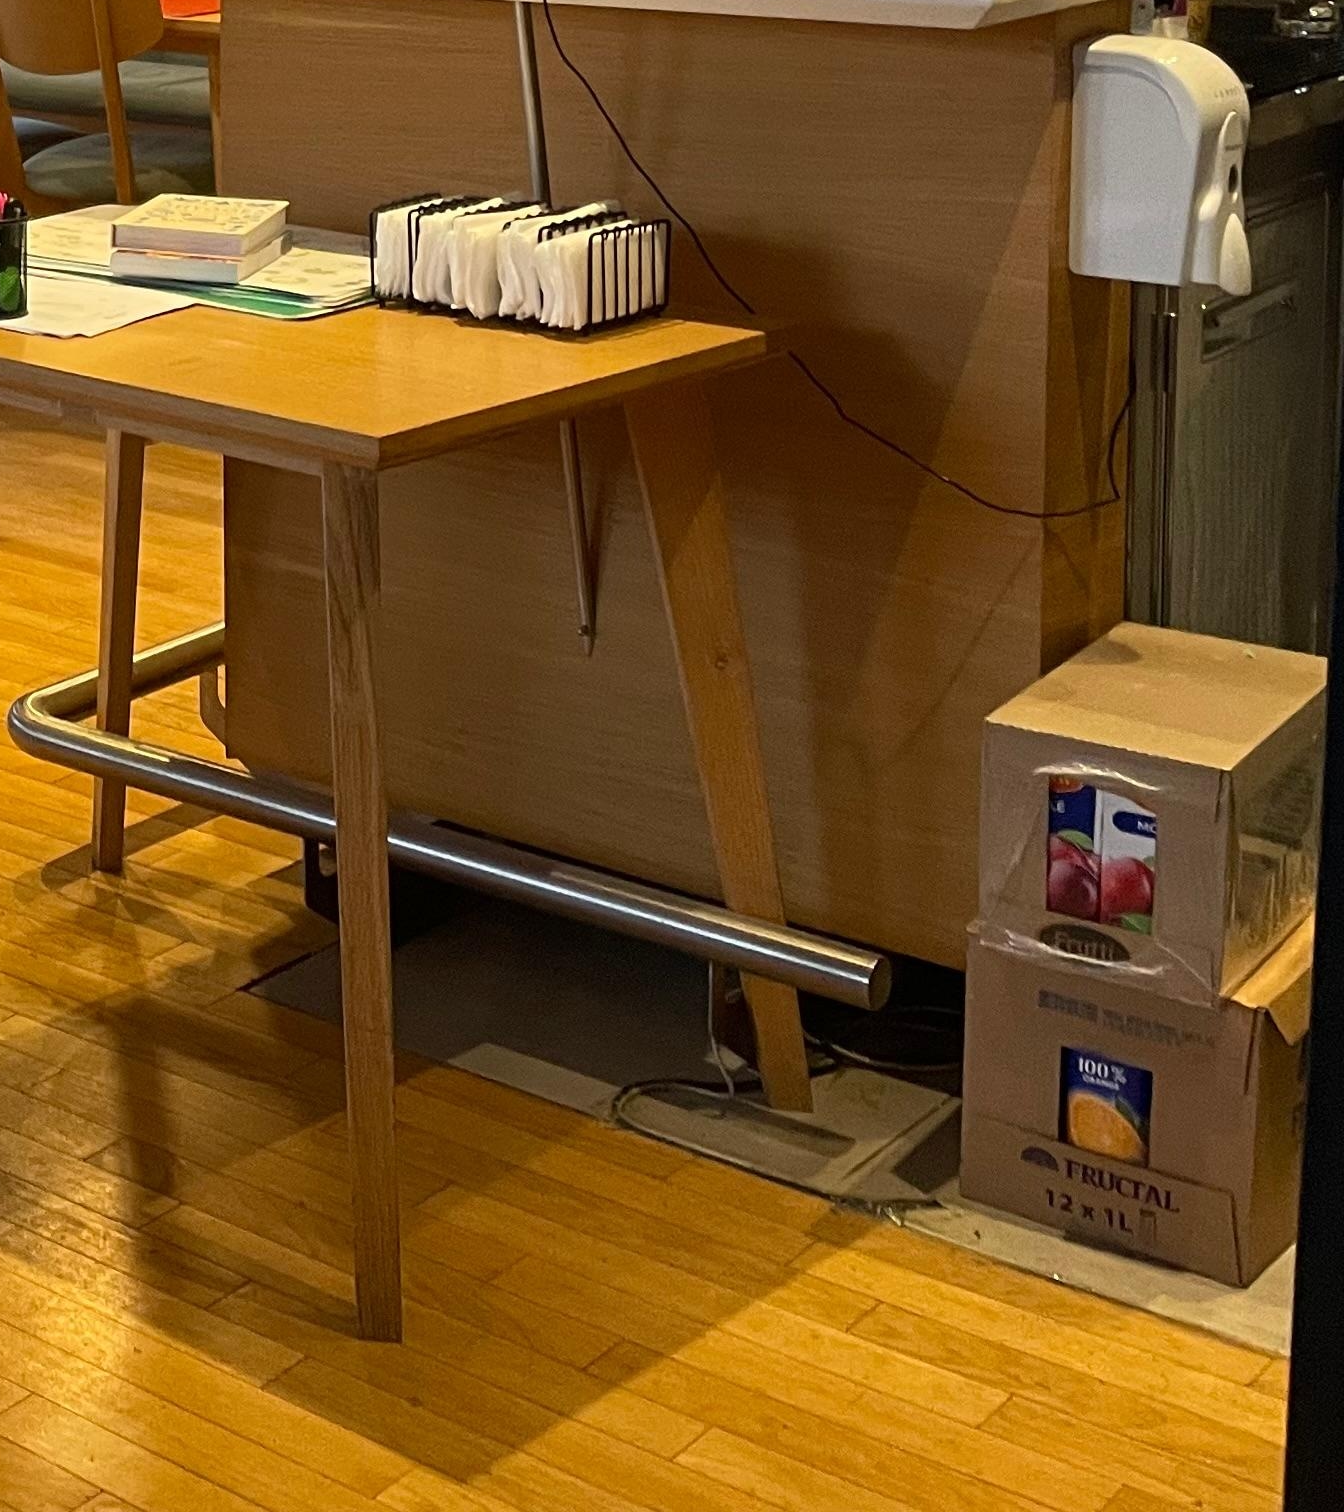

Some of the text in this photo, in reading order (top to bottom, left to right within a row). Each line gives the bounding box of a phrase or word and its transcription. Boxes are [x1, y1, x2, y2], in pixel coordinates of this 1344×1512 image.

[1064, 1158, 1181, 1213] FRUCTAL
[1046, 1188, 1135, 1236] 12 x 1L
